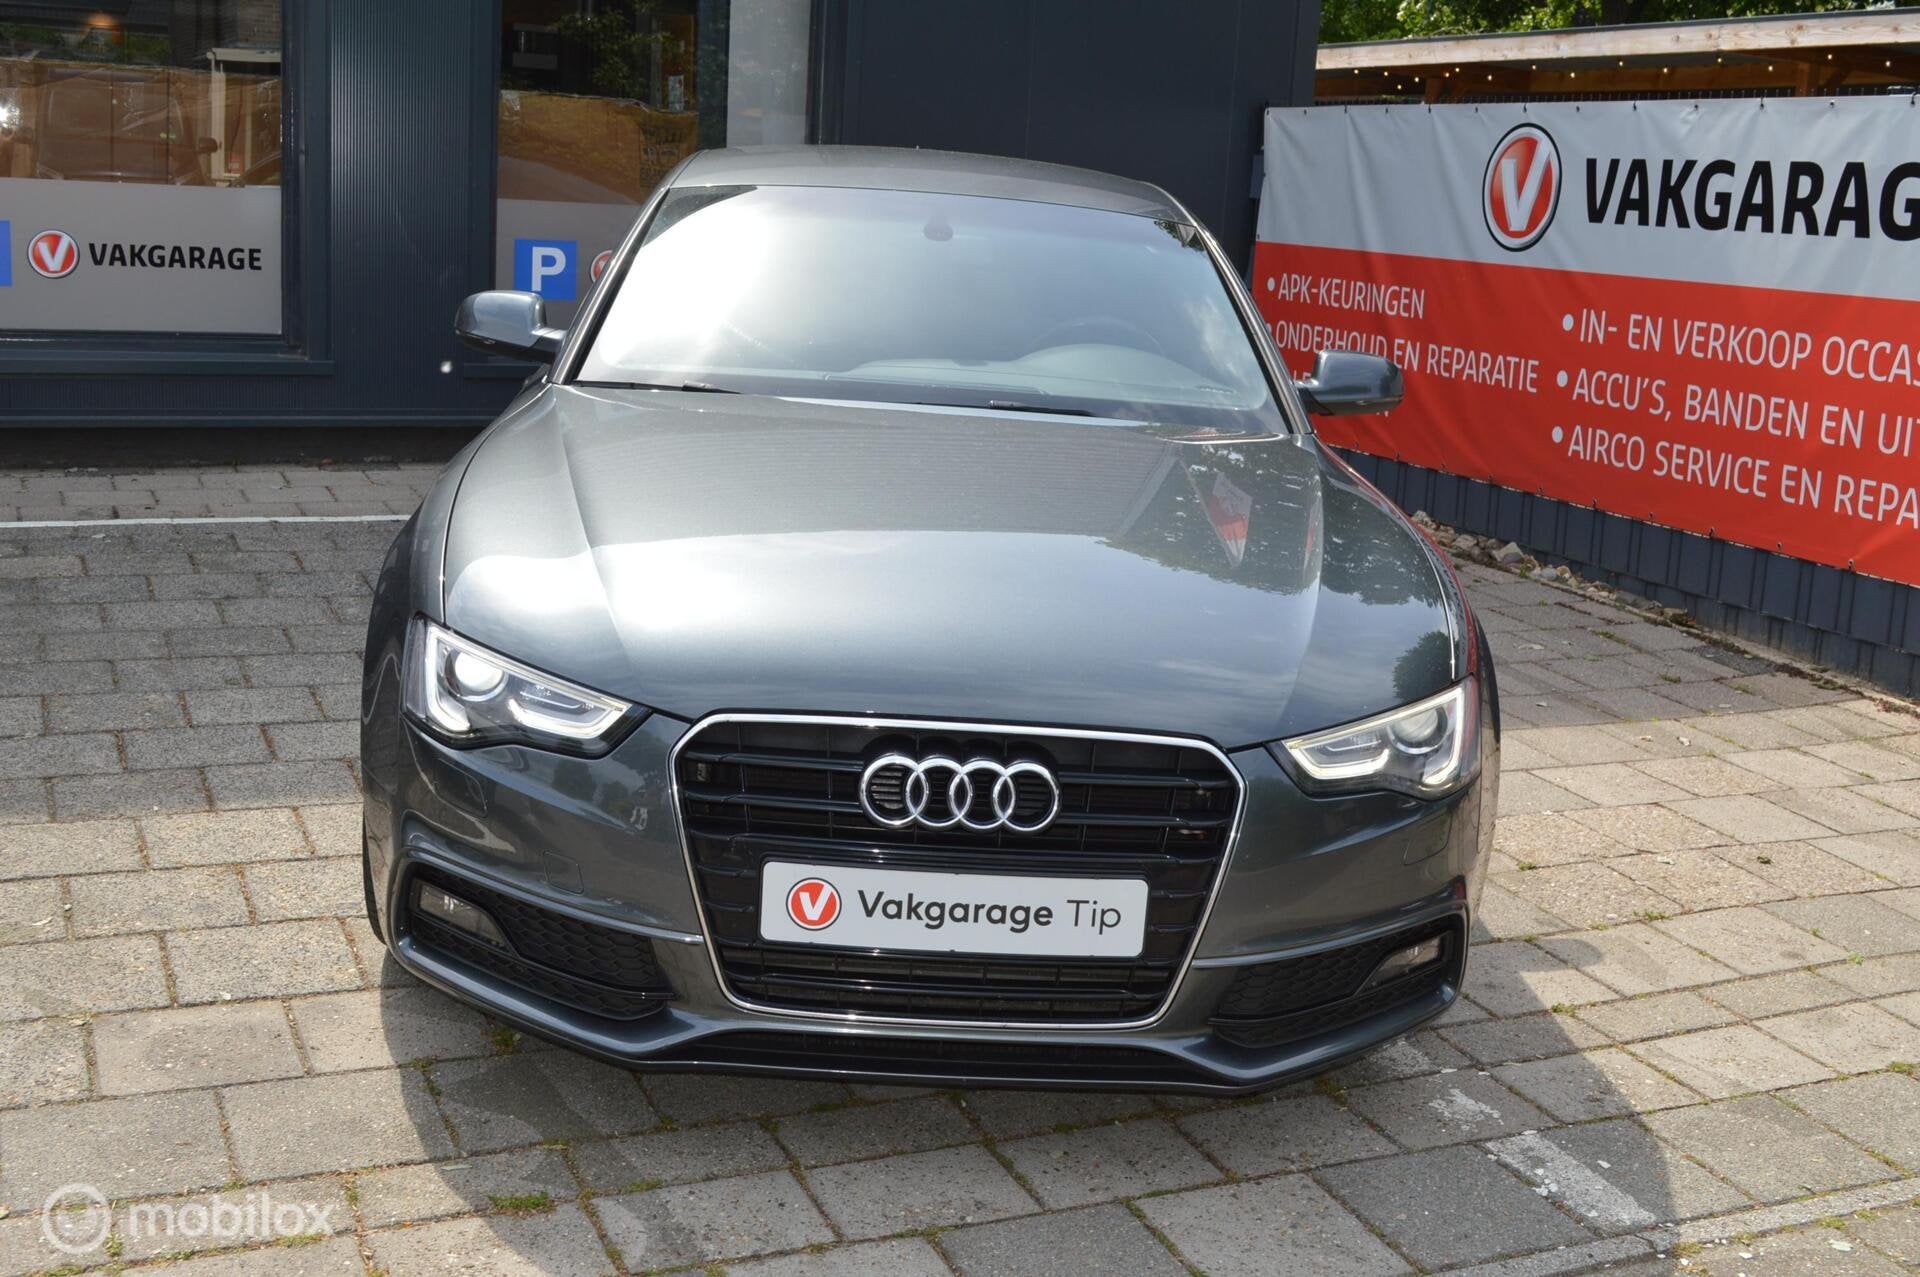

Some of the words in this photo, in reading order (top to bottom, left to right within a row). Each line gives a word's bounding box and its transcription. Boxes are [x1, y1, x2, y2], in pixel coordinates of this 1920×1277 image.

[1585, 157, 1920, 242] VAKGARAG
[88, 242, 262, 271] VAKGARAGE
[531, 246, 567, 292] P
[1278, 272, 1425, 320] APK-KEURINGEN
[1275, 319, 1388, 358] ONDERHOUD
[1393, 338, 1420, 372] EN
[1426, 343, 1540, 393] REPARATIE
[1580, 308, 1618, 345] IN-
[1627, 313, 1663, 352] EN
[1673, 318, 1812, 370] VERKOOP
[1572, 367, 1671, 422] ACCU'S,
[1684, 384, 1809, 440] BANDEN
[1820, 404, 1865, 449] EN
[1877, 412, 1920, 457] UI
[1567, 424, 1645, 472] AIRCO
[1652, 440, 1770, 498] SERVICE
[1780, 463, 1822, 509] EN
[1834, 474, 1919, 530] REPA
[857, 889, 1053, 934] Vakgarage
[1066, 899, 1121, 935] Tip
